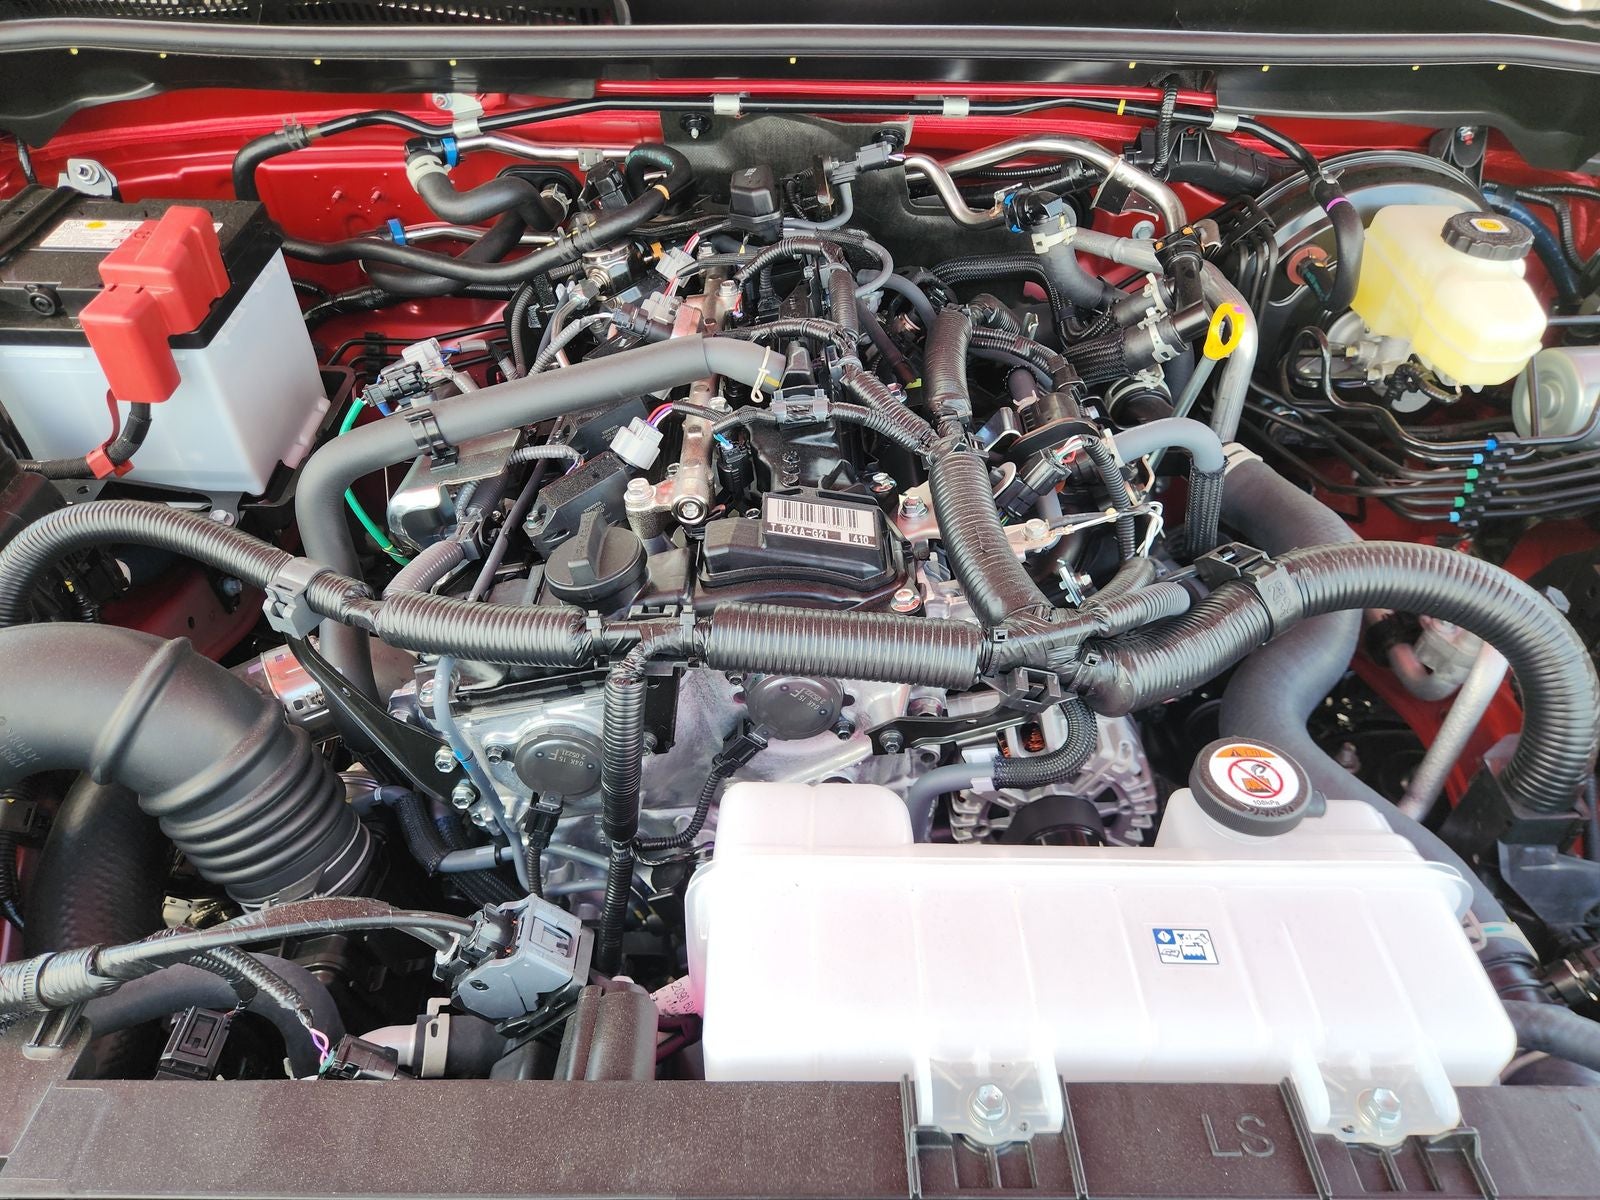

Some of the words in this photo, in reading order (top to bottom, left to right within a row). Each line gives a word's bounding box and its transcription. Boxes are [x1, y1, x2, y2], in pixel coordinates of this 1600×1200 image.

[770, 523, 777, 532] T
[781, 524, 830, 540] T24A-G21
[852, 535, 870, 546] 410
[1200, 1112, 1276, 1158] LS
